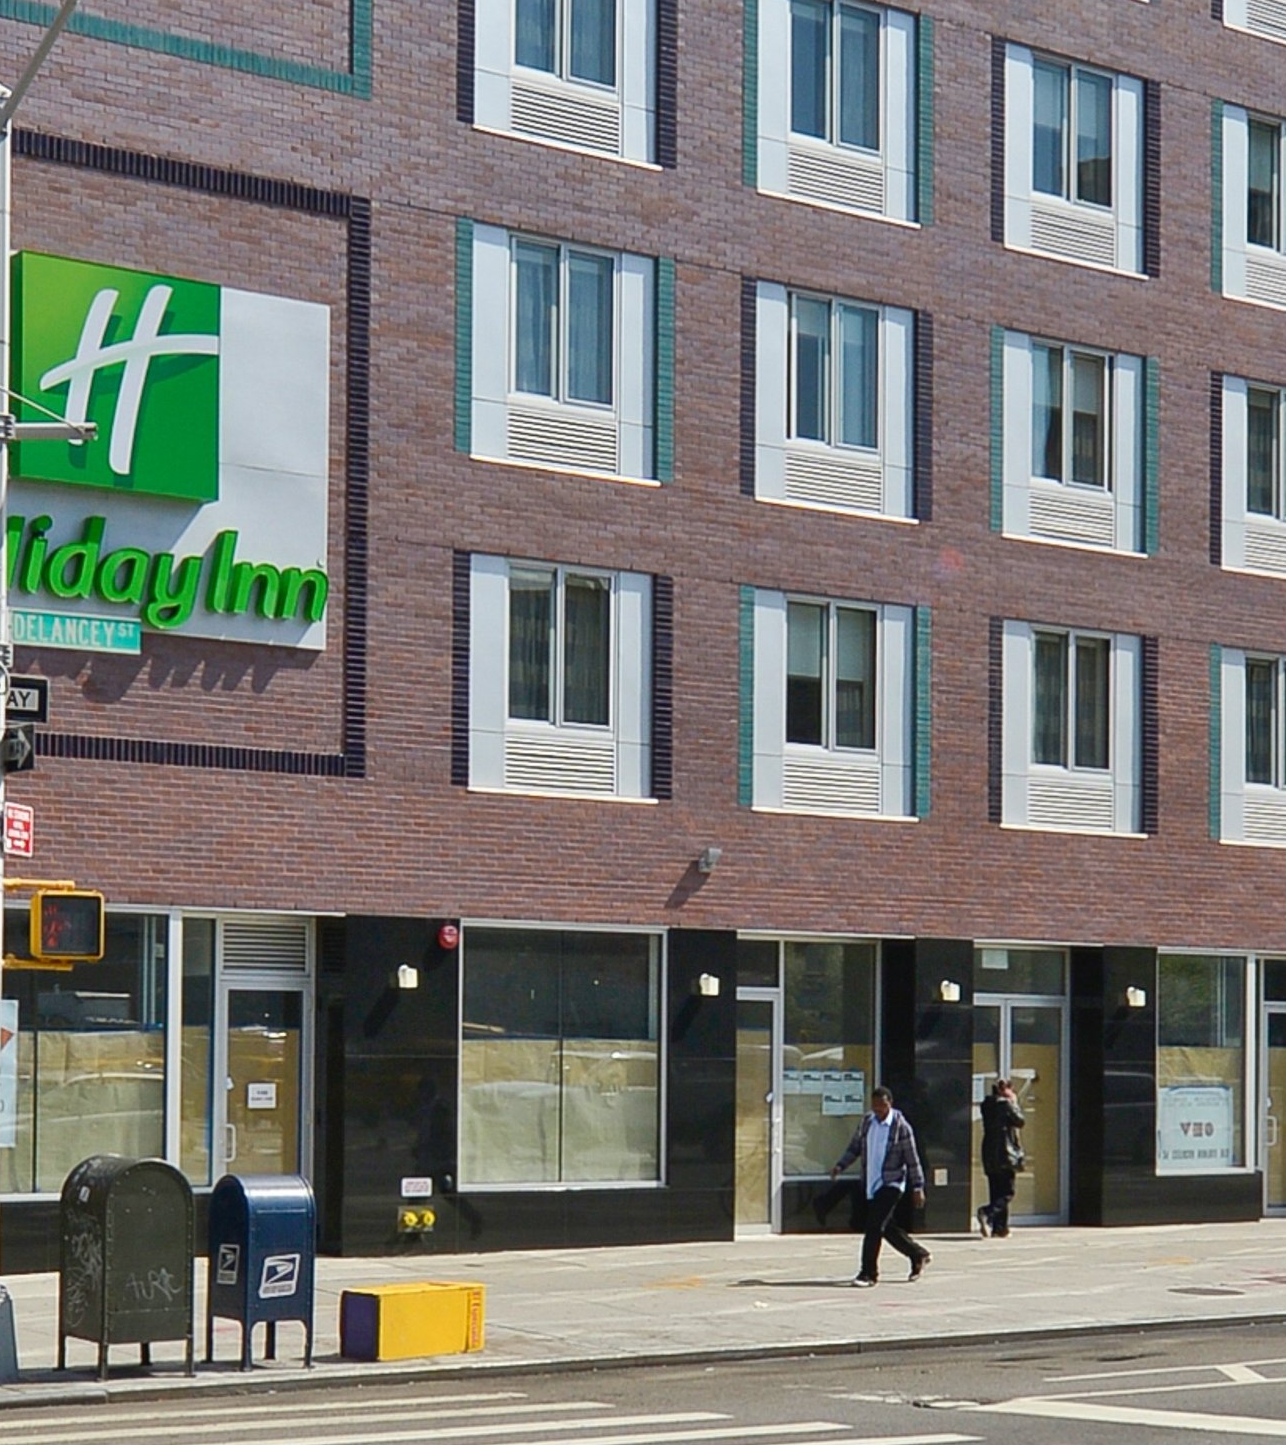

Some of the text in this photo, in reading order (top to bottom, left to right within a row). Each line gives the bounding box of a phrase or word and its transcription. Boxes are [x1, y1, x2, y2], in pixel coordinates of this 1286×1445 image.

[206, 529, 329, 623] Inn
[14, 613, 135, 648] DELANCEY ST
